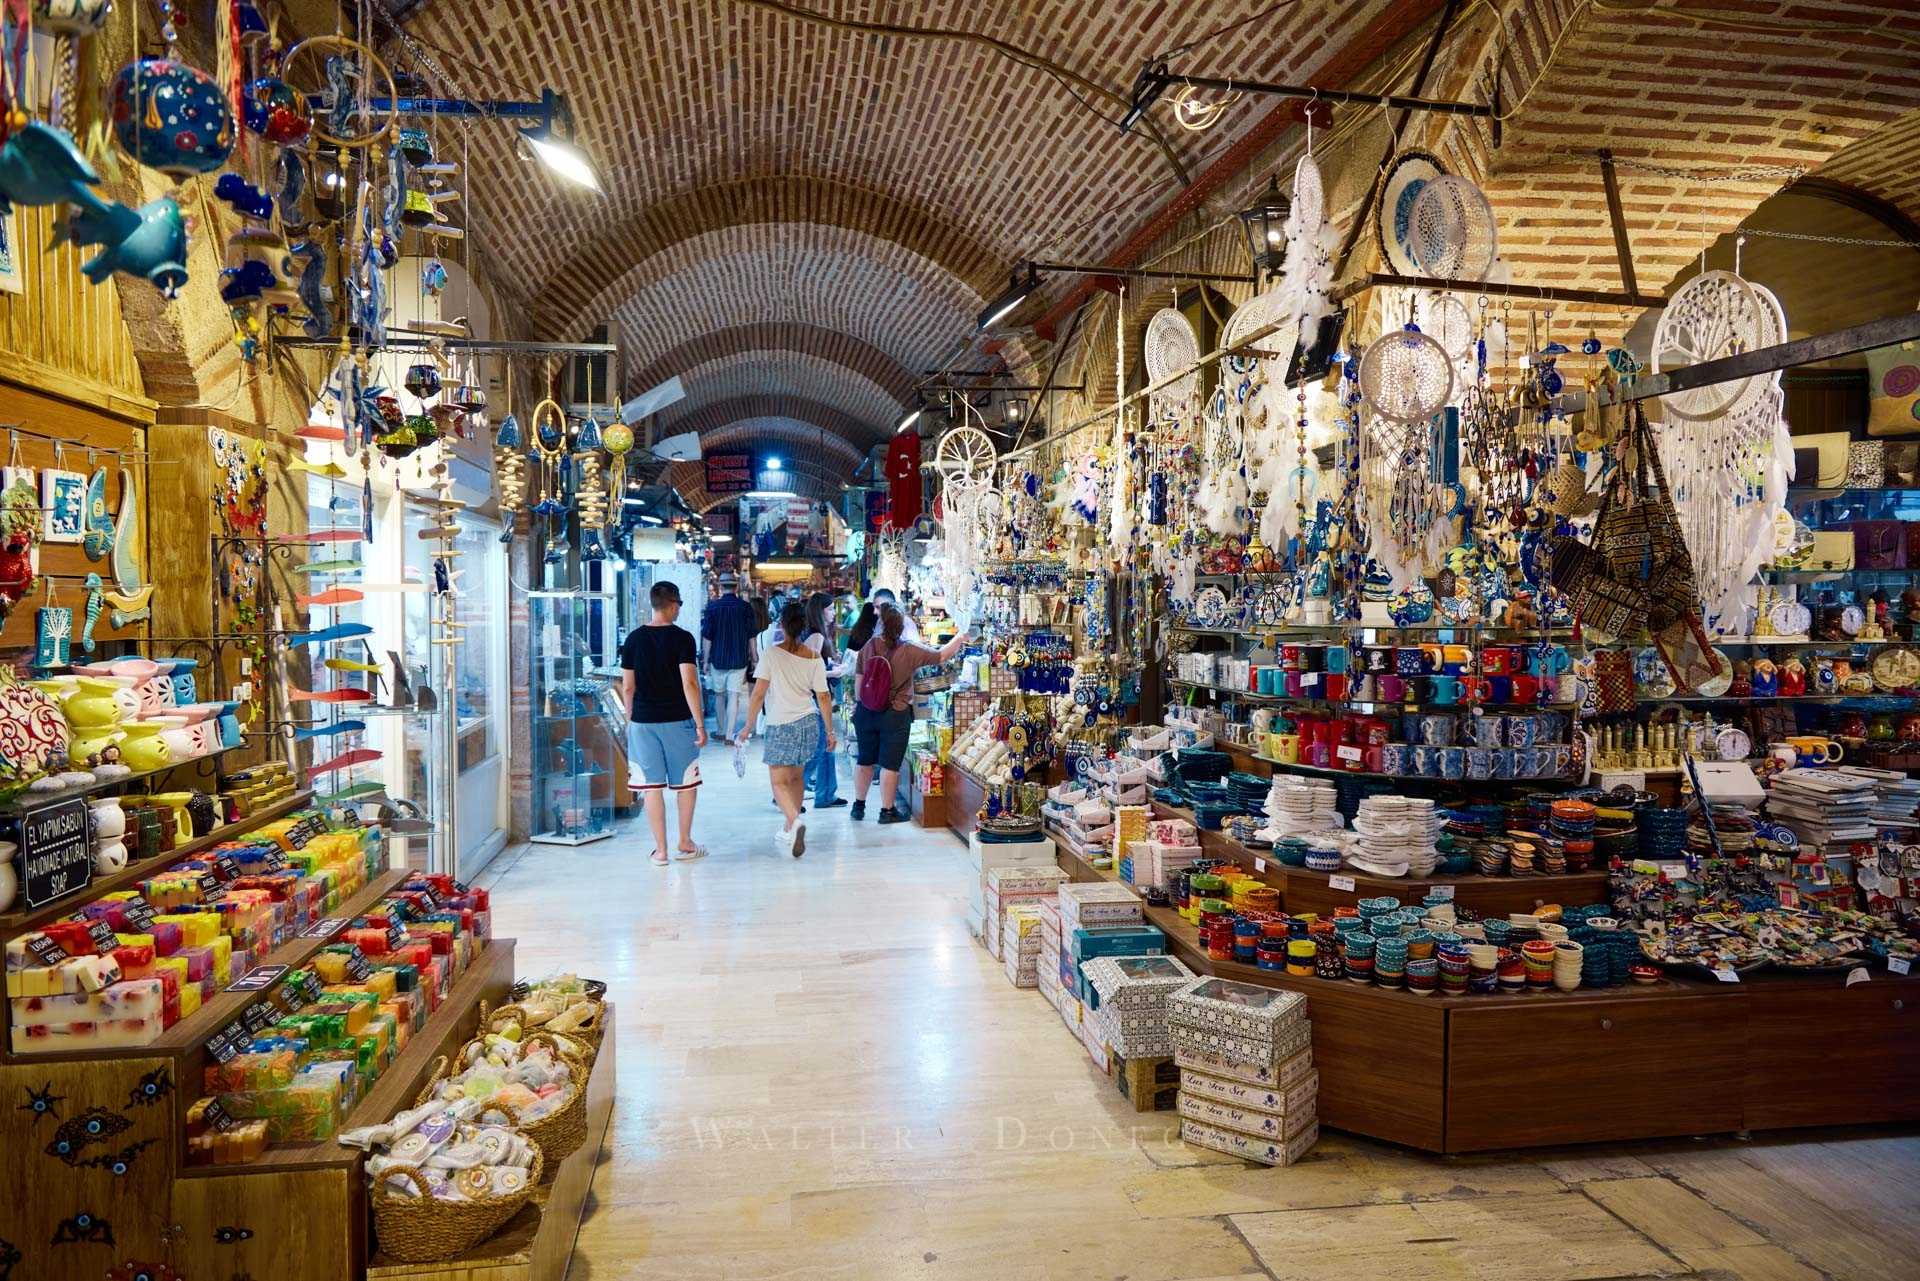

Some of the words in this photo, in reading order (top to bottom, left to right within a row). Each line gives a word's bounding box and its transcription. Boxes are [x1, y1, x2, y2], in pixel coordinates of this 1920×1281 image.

[28, 826, 38, 846] EL
[61, 811, 85, 835] SABUN
[27, 851, 61, 880] HANDMADE
[61, 841, 88, 867] NATURAL
[50, 871, 68, 896] SOAP
[1229, 1087, 1246, 1098] Set
[1227, 1110, 1244, 1122] Set
[1231, 1136, 1248, 1148] Set
